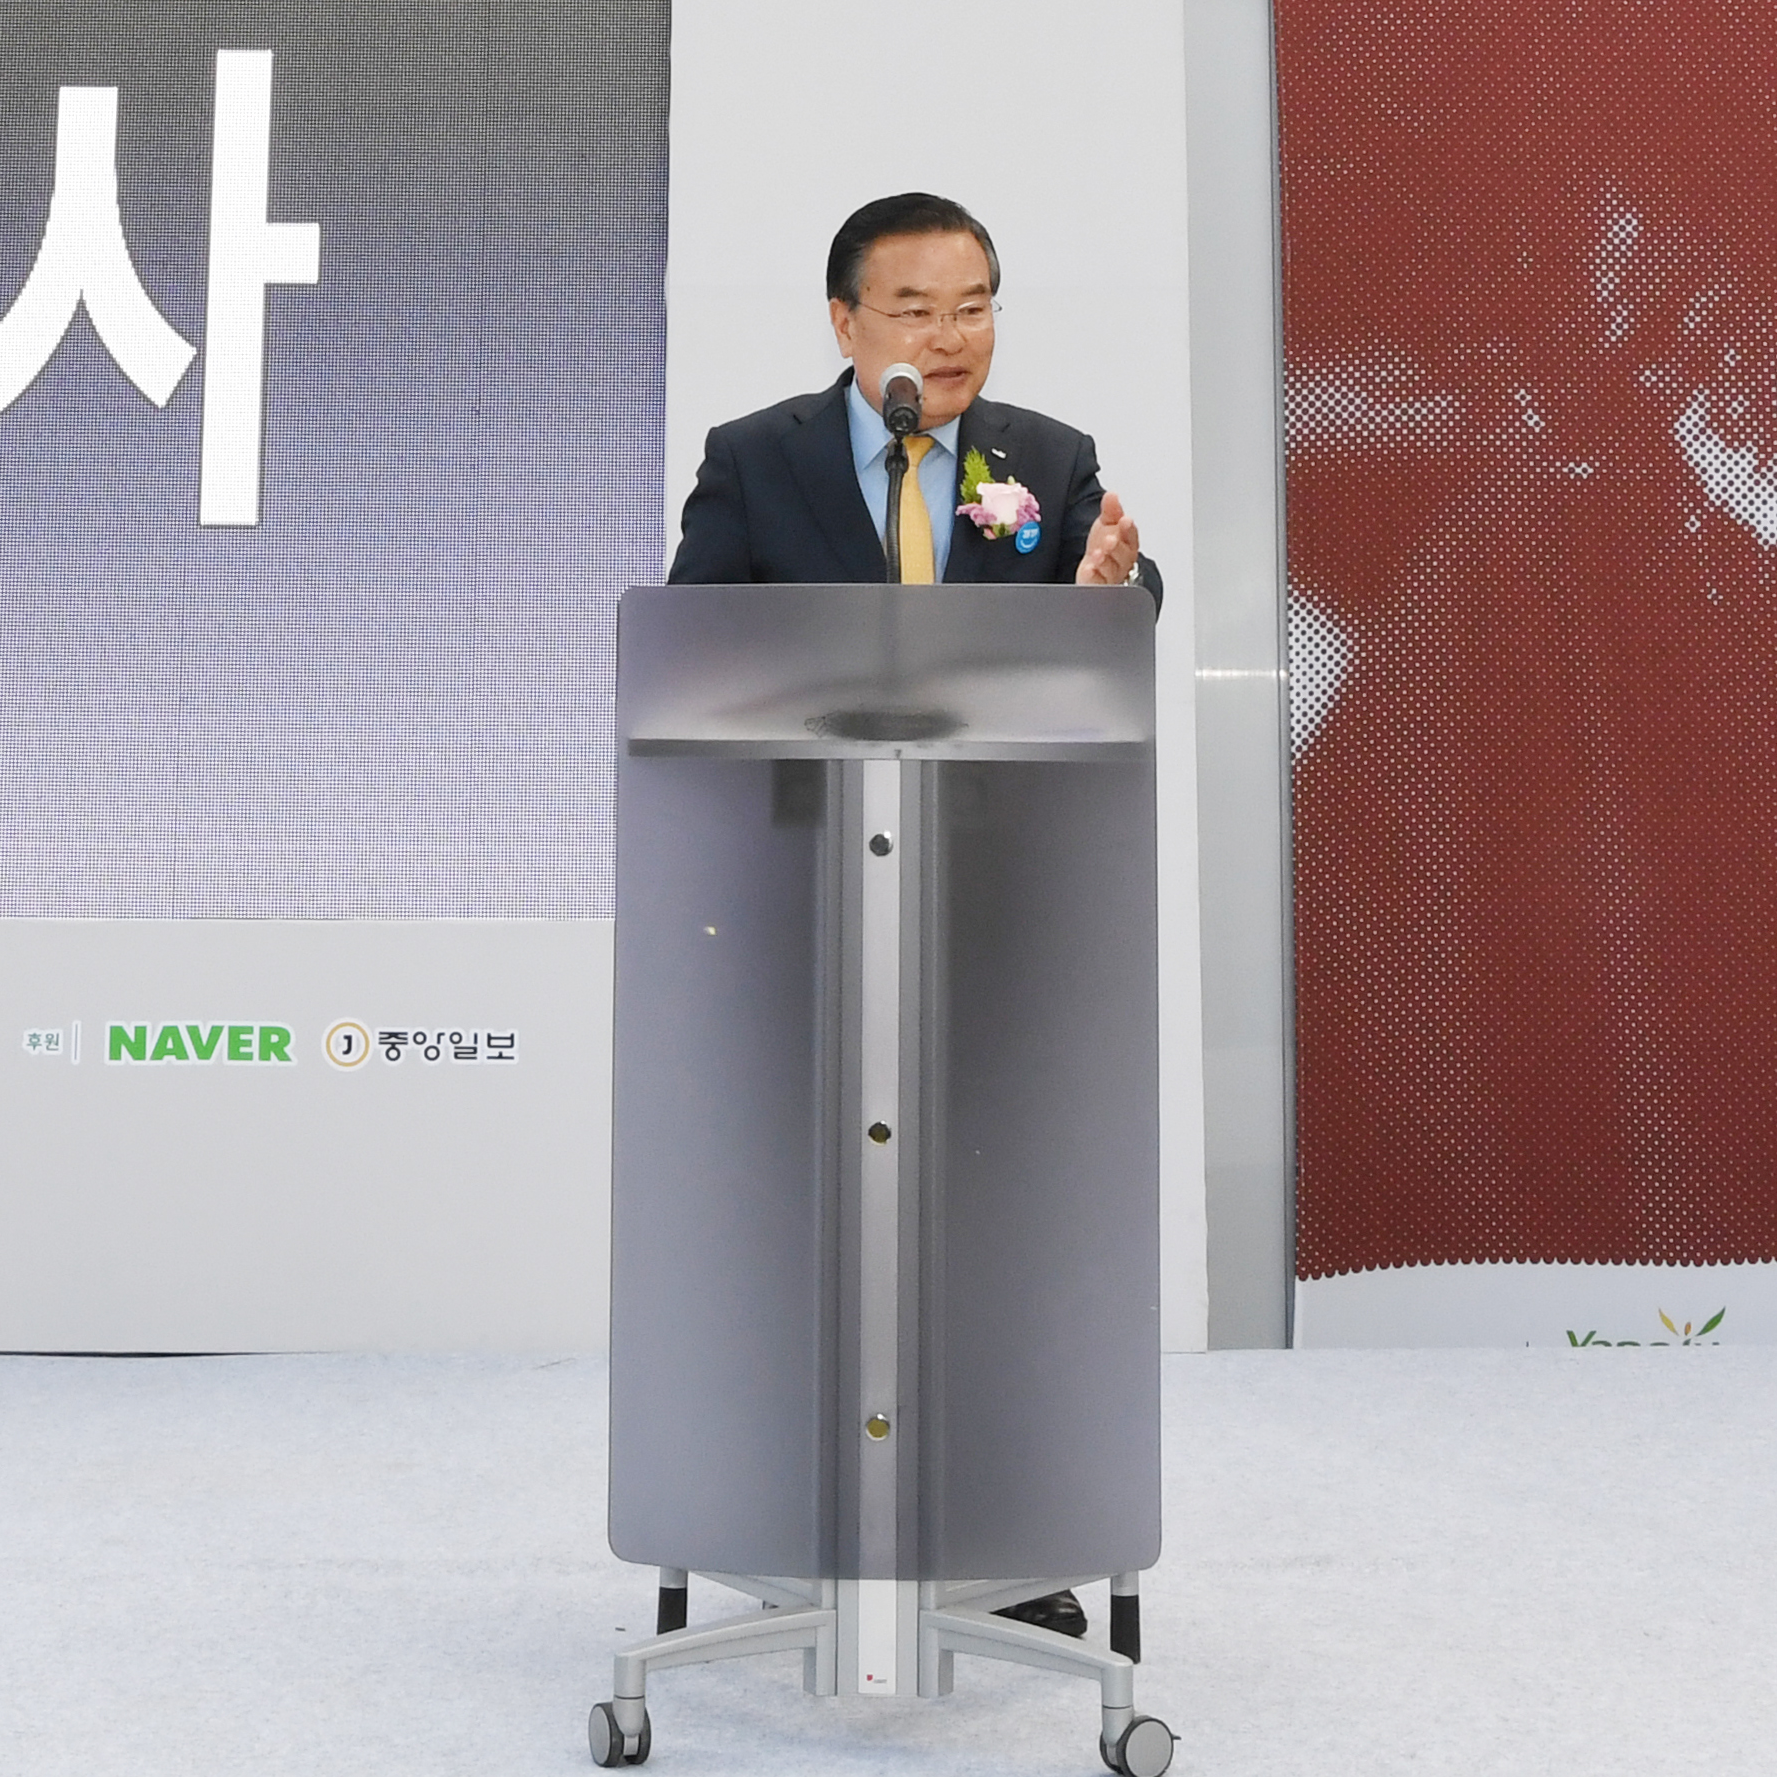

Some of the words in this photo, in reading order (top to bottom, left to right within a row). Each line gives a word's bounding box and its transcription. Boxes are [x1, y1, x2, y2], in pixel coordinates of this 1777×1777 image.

[26, 1031, 61, 1052] 후원
[107, 1024, 293, 1063] NAVER
[377, 1031, 516, 1063] 중앙일보
